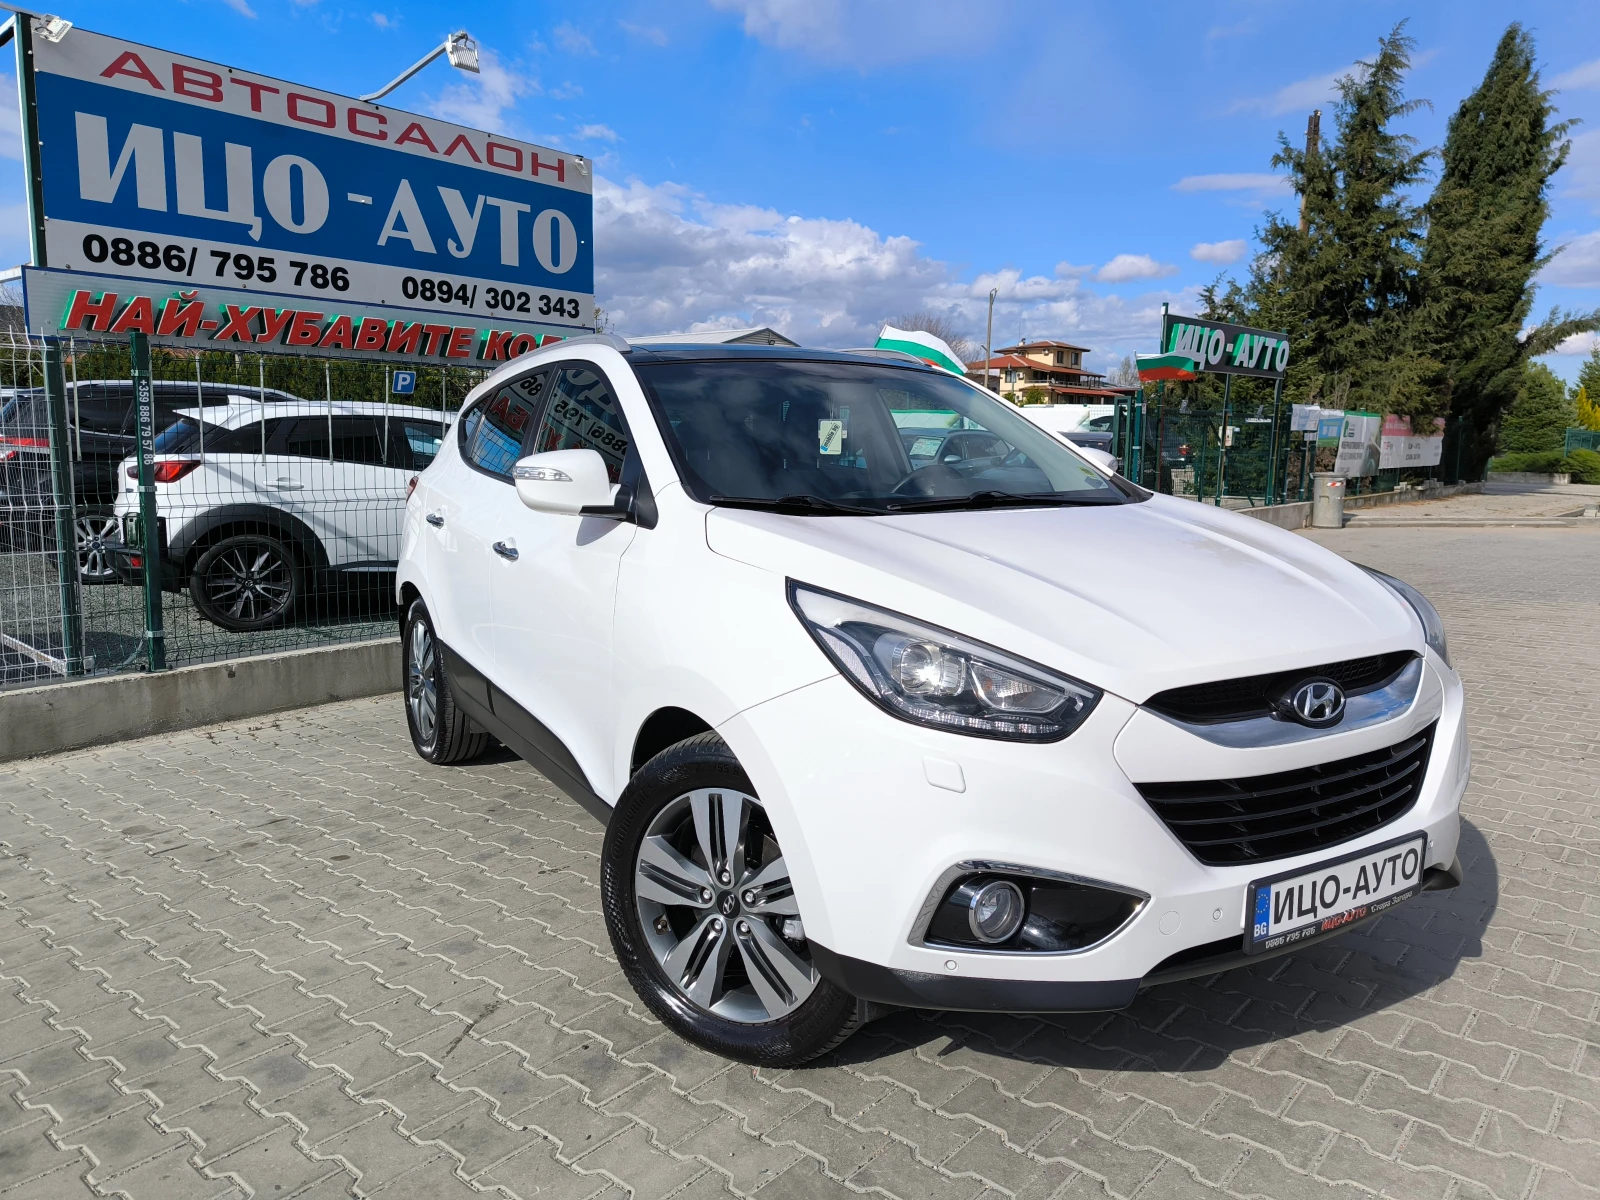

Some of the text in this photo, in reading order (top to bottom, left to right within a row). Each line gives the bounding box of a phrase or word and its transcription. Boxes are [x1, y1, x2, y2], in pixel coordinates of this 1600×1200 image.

[99, 50, 566, 183] АВТОСАЛОН
[82, 233, 350, 292] 0886/ 795 786
[401, 275, 580, 319] 0894/ 302 343
[63, 290, 476, 359] НАЙ-ХУБАВИТЕ
[1172, 323, 1290, 373] ИЦО-АУТО
[397, 373, 411, 391] P
[138, 379, 154, 465] +359 886 79 57 86
[1274, 848, 1418, 925] ИЦО-АУТО
[1254, 922, 1267, 938] BG
[1286, 931, 1301, 943] 795
